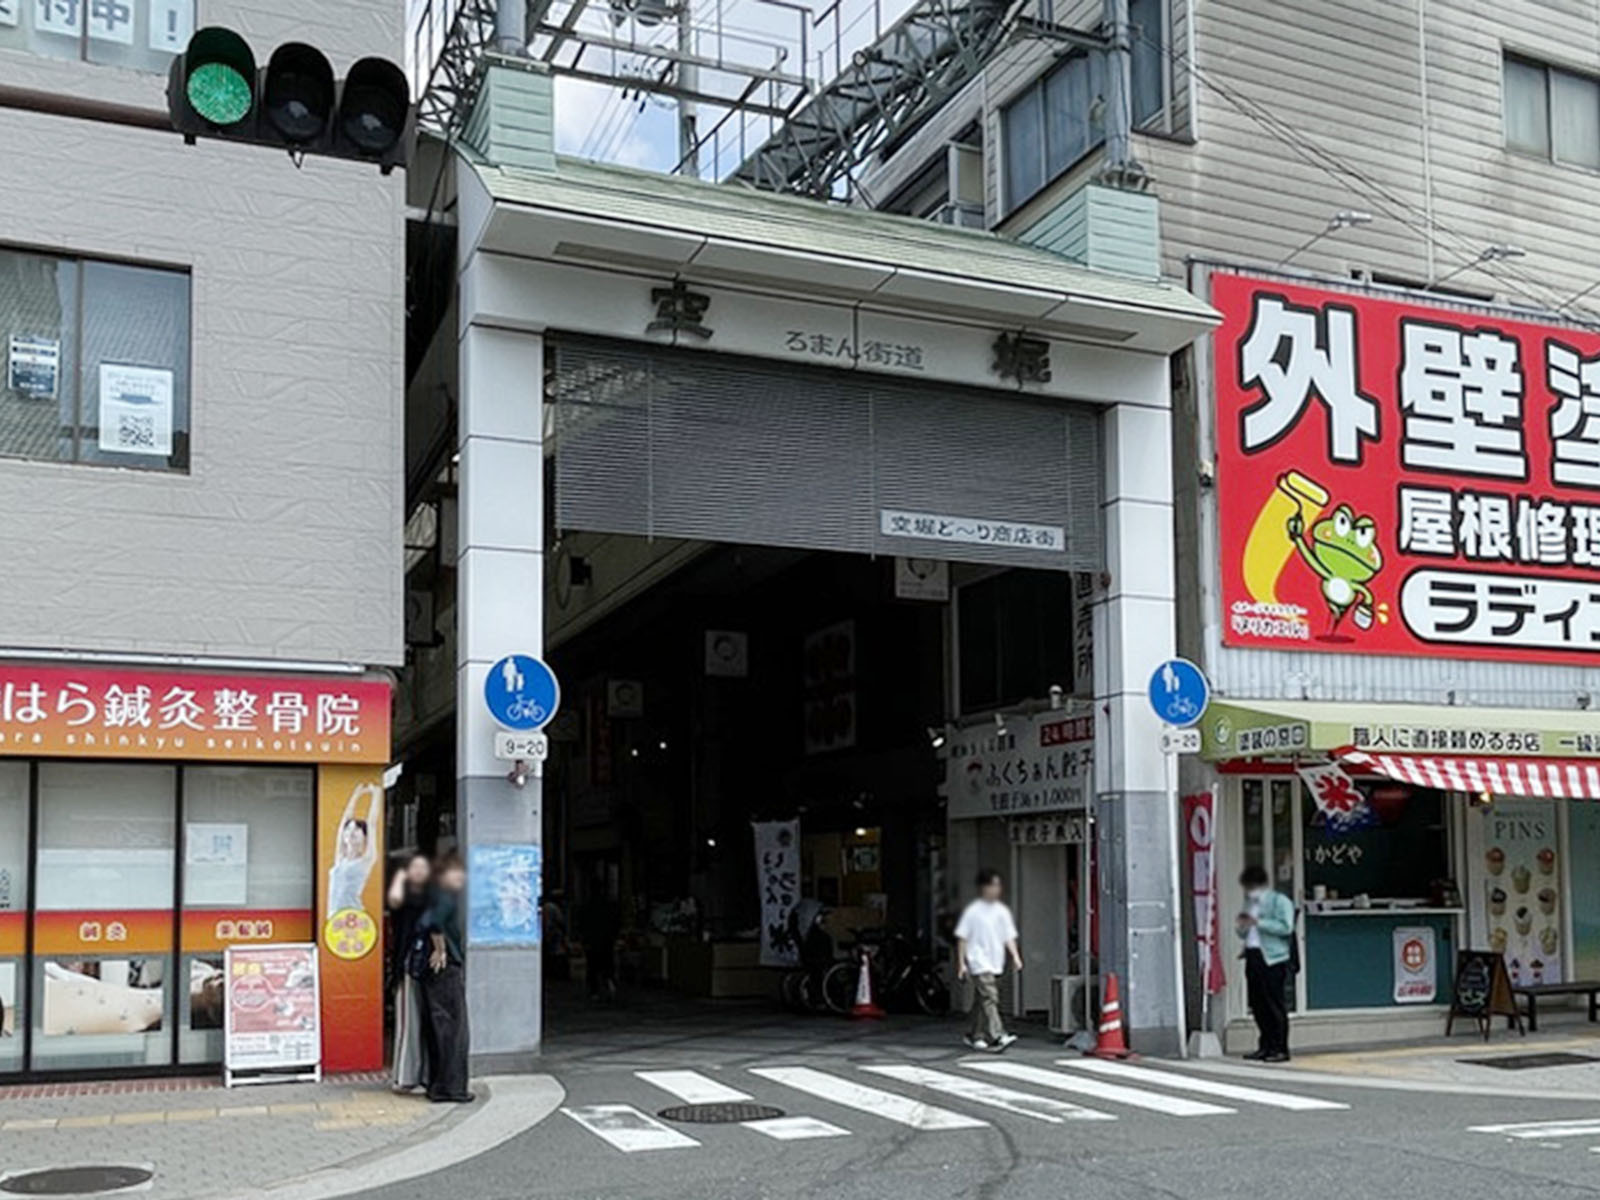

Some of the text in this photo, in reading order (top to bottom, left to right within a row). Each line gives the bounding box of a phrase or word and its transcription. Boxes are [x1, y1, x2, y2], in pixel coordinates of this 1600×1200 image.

[785, 330, 926, 371] ろまん街道
[1427, 578, 1600, 644] ラディ
[3, 682, 361, 735] はら鍼灸整骨院
[66, 732, 184, 749] shinkyu
[206, 738, 361, 752] seikotsuin
[505, 738, 546, 756] 9-20
[1161, 733, 1200, 750] 9-20
[1560, 734, 1600, 753] 一級
[1494, 820, 1547, 841] PINS
